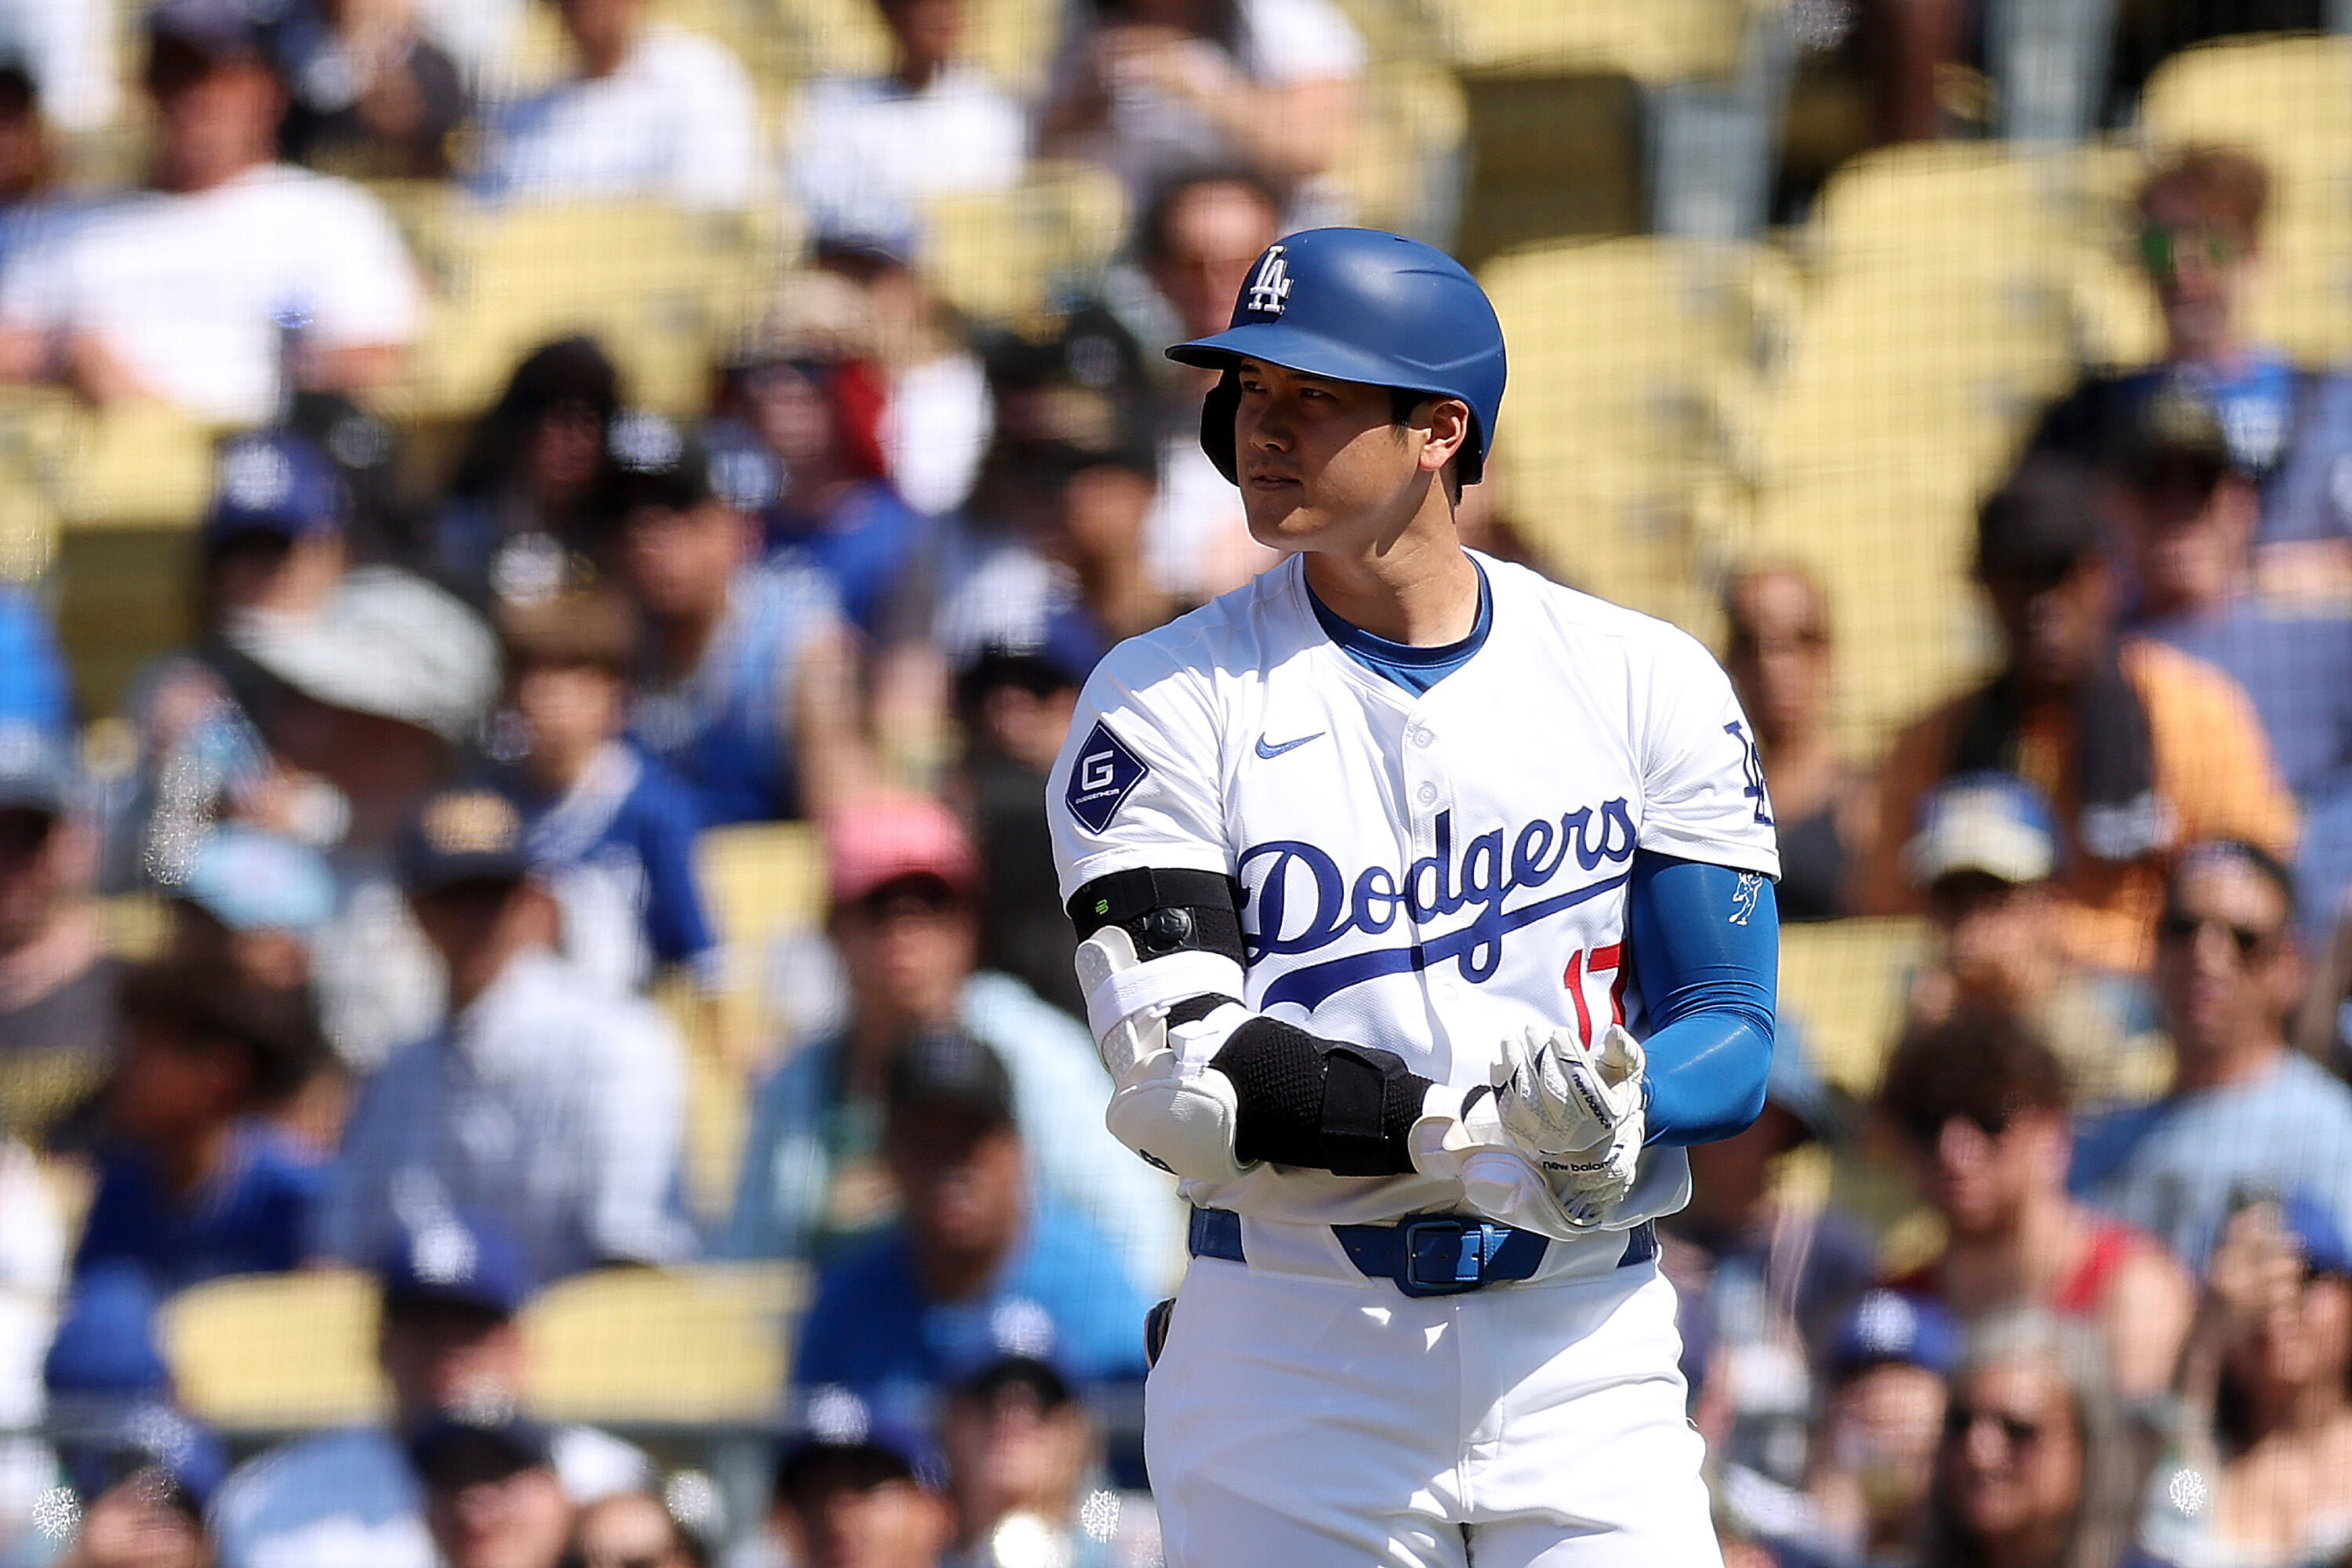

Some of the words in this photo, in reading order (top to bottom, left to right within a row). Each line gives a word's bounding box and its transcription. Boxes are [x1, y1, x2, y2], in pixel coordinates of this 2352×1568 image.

[1247, 245, 1292, 314] LA
[1082, 750, 1113, 791] G
[1236, 797, 1638, 984] Dodgers
[1564, 941, 1628, 1051] 17
[1572, 1073, 1588, 1095] new
[1543, 1161, 1568, 1171] new
